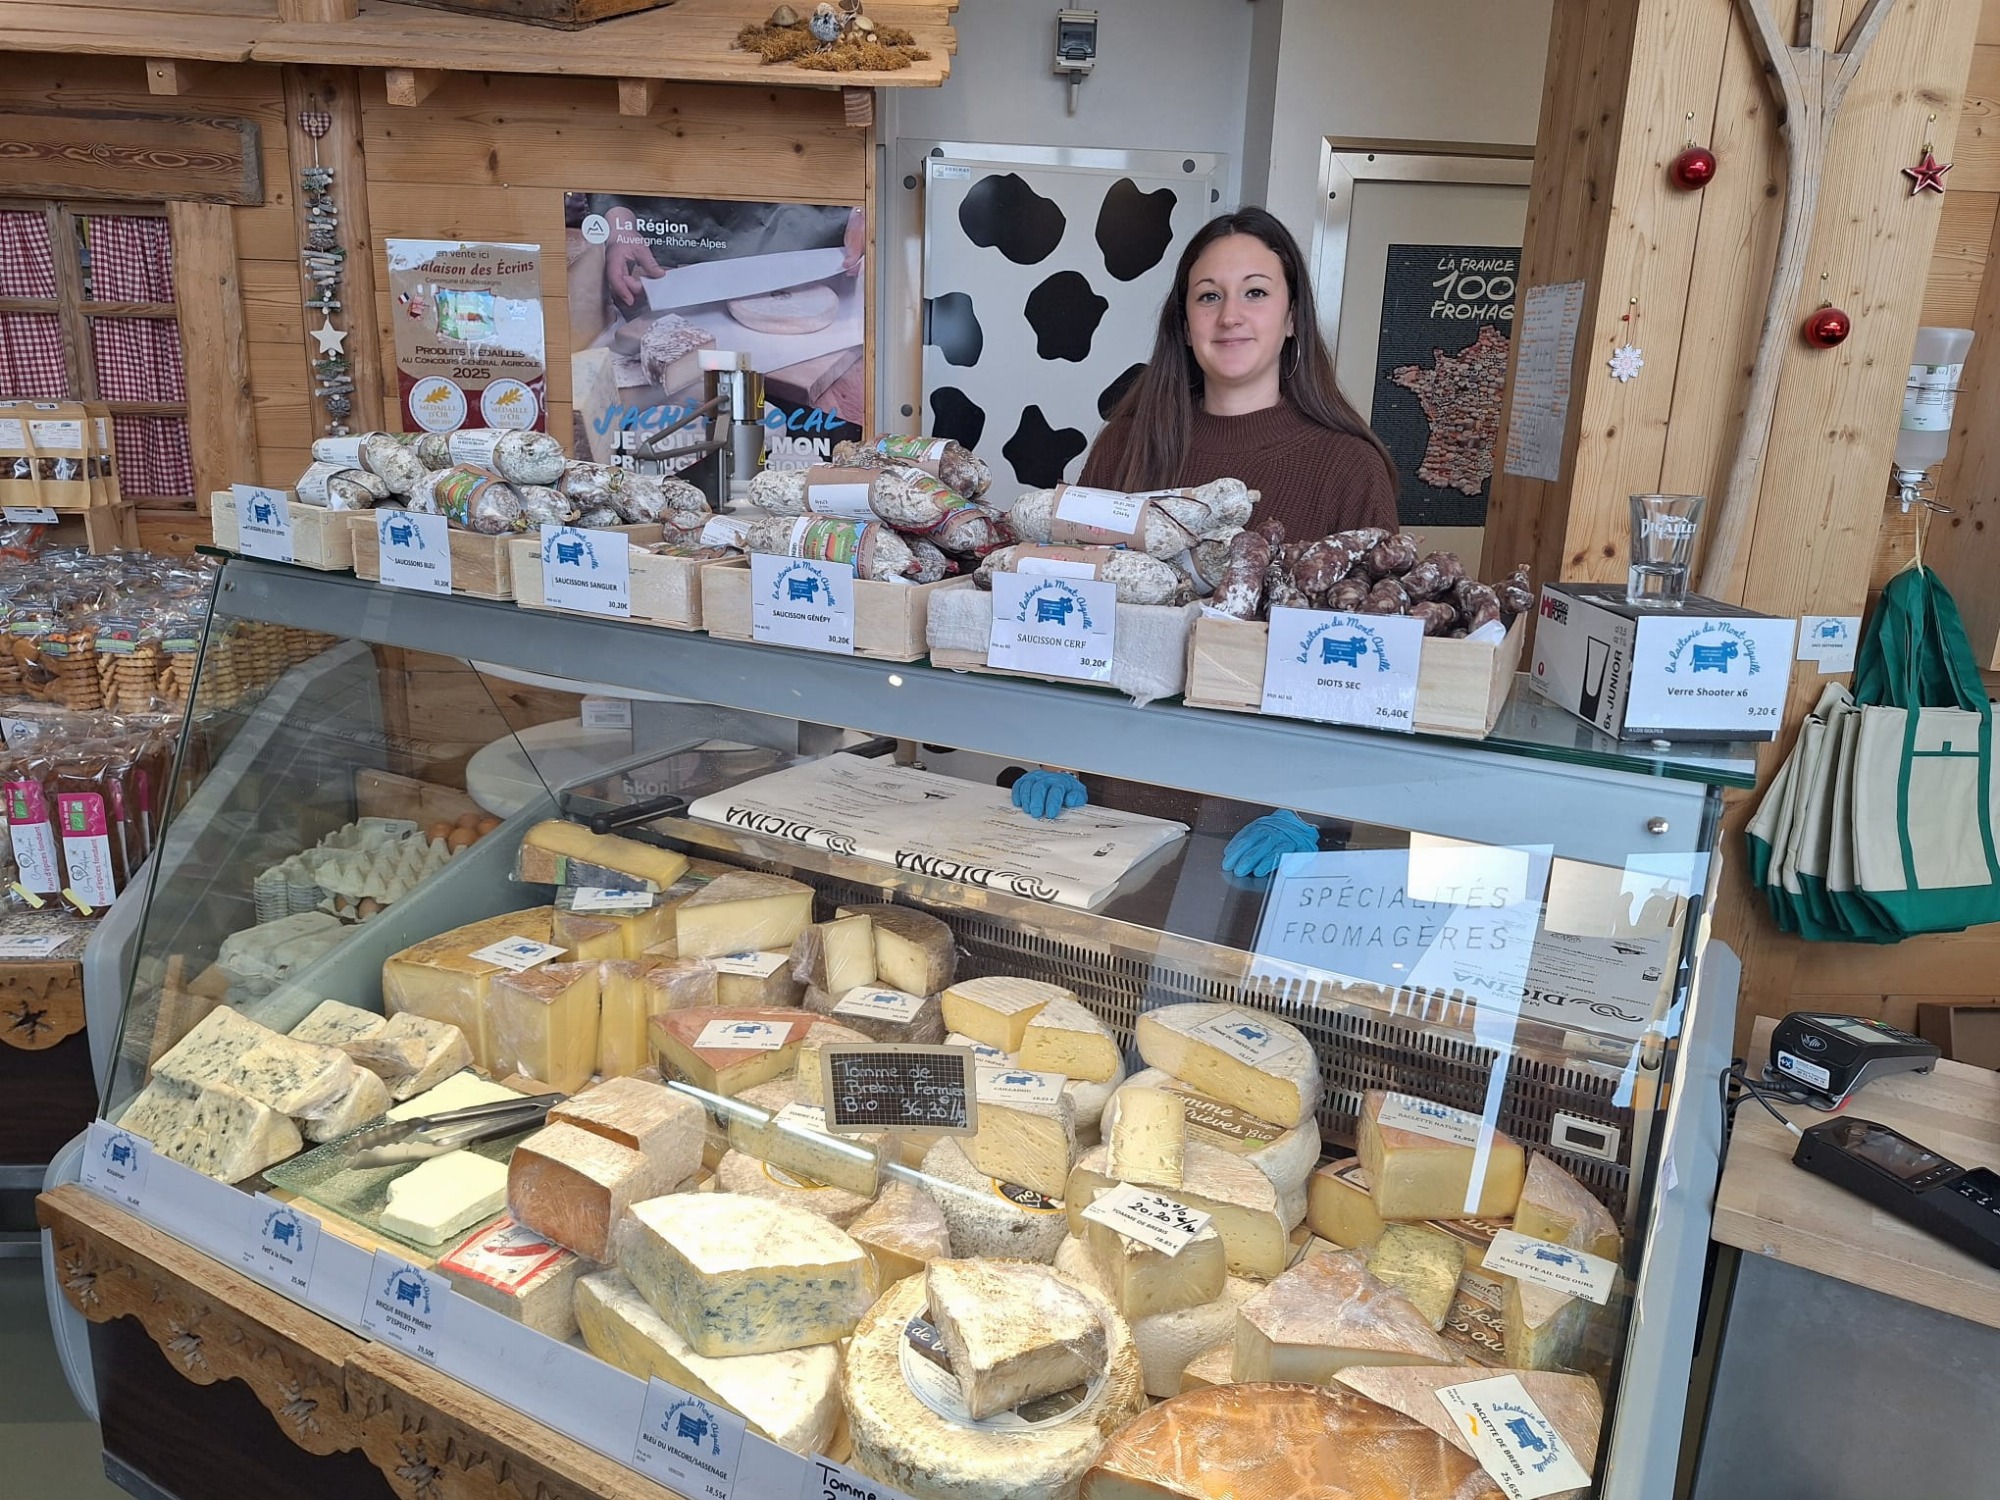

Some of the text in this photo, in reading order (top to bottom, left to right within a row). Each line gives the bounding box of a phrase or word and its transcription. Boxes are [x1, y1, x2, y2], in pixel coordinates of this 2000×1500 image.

[616, 218, 689, 235] La Région
[616, 234, 727, 250] Auvergne-Rhône-Alpes
[450, 250, 477, 258] vente
[414, 259, 534, 275] alaison des Écrins
[1438, 257, 1514, 271] LA FRANCE
[1433, 269, 1516, 301] 100
[415, 345, 466, 356] PRODUITS
[415, 357, 459, 366] CONCOURS
[501, 359, 540, 369] AGRICOLE
[453, 368, 491, 379] 2025
[757, 407, 846, 432] OCAL
[611, 431, 636, 450] JE
[772, 436, 831, 456] MON
[395, 558, 424, 568] SAUCISSONS
[555, 577, 589, 588] SAUCISSONS
[608, 600, 629, 610] 30,20€
[773, 610, 831, 623] SAUCISSON GÉNÉPY
[1331, 616, 1344, 628] du
[1702, 622, 1716, 634] du
[828, 634, 850, 645] 30,20€
[1017, 633, 1062, 647] SAUCISSON
[1064, 639, 1088, 649] CERF
[1300, 625, 1331, 653] laiterie
[1669, 630, 1701, 661] laiterie
[1079, 657, 1108, 668] 30,20€
[1296, 650, 1308, 665] la
[1664, 660, 1677, 674] la
[1317, 678, 1362, 691] DIOTS SEC
[1610, 650, 1623, 710] JUNIOR
[1667, 687, 1749, 698] Verre Shooter x6
[1375, 706, 1410, 719] 26,40€
[1746, 706, 1778, 717] 9,20 €
[724, 806, 811, 843] DICINA
[90, 839, 99, 864] fondant
[895, 849, 992, 889] DICINA
[1299, 878, 1510, 909] SPÉCIALITÉS
[1283, 915, 1509, 951] FROMAGÈRES
[1453, 971, 1566, 1006] DICINA
[835, 1059, 934, 1079] Tomme de
[843, 1096, 879, 1113] Bio
[1180, 1095, 1234, 1117] mme
[1397, 1113, 1463, 1133] RACLETTE NATURE
[1244, 1128, 1273, 1141] Bio
[1112, 1207, 1169, 1236] TOMME DE BREBIS
[1499, 1256, 1594, 1289] RACLETTE AIL DES OURS
[375, 1299, 432, 1331] BRIQUE BREBIS PIMENT
[385, 1315, 417, 1335] D'ESPELETTE
[1447, 1316, 1469, 1332] es
[911, 1326, 931, 1342] de
[1471, 1401, 1526, 1476] RACLETTE DE BREBIS
[642, 1432, 728, 1481] BLEU DU VERCORS/SASSENAGE
[816, 1461, 878, 1500] Tomme
